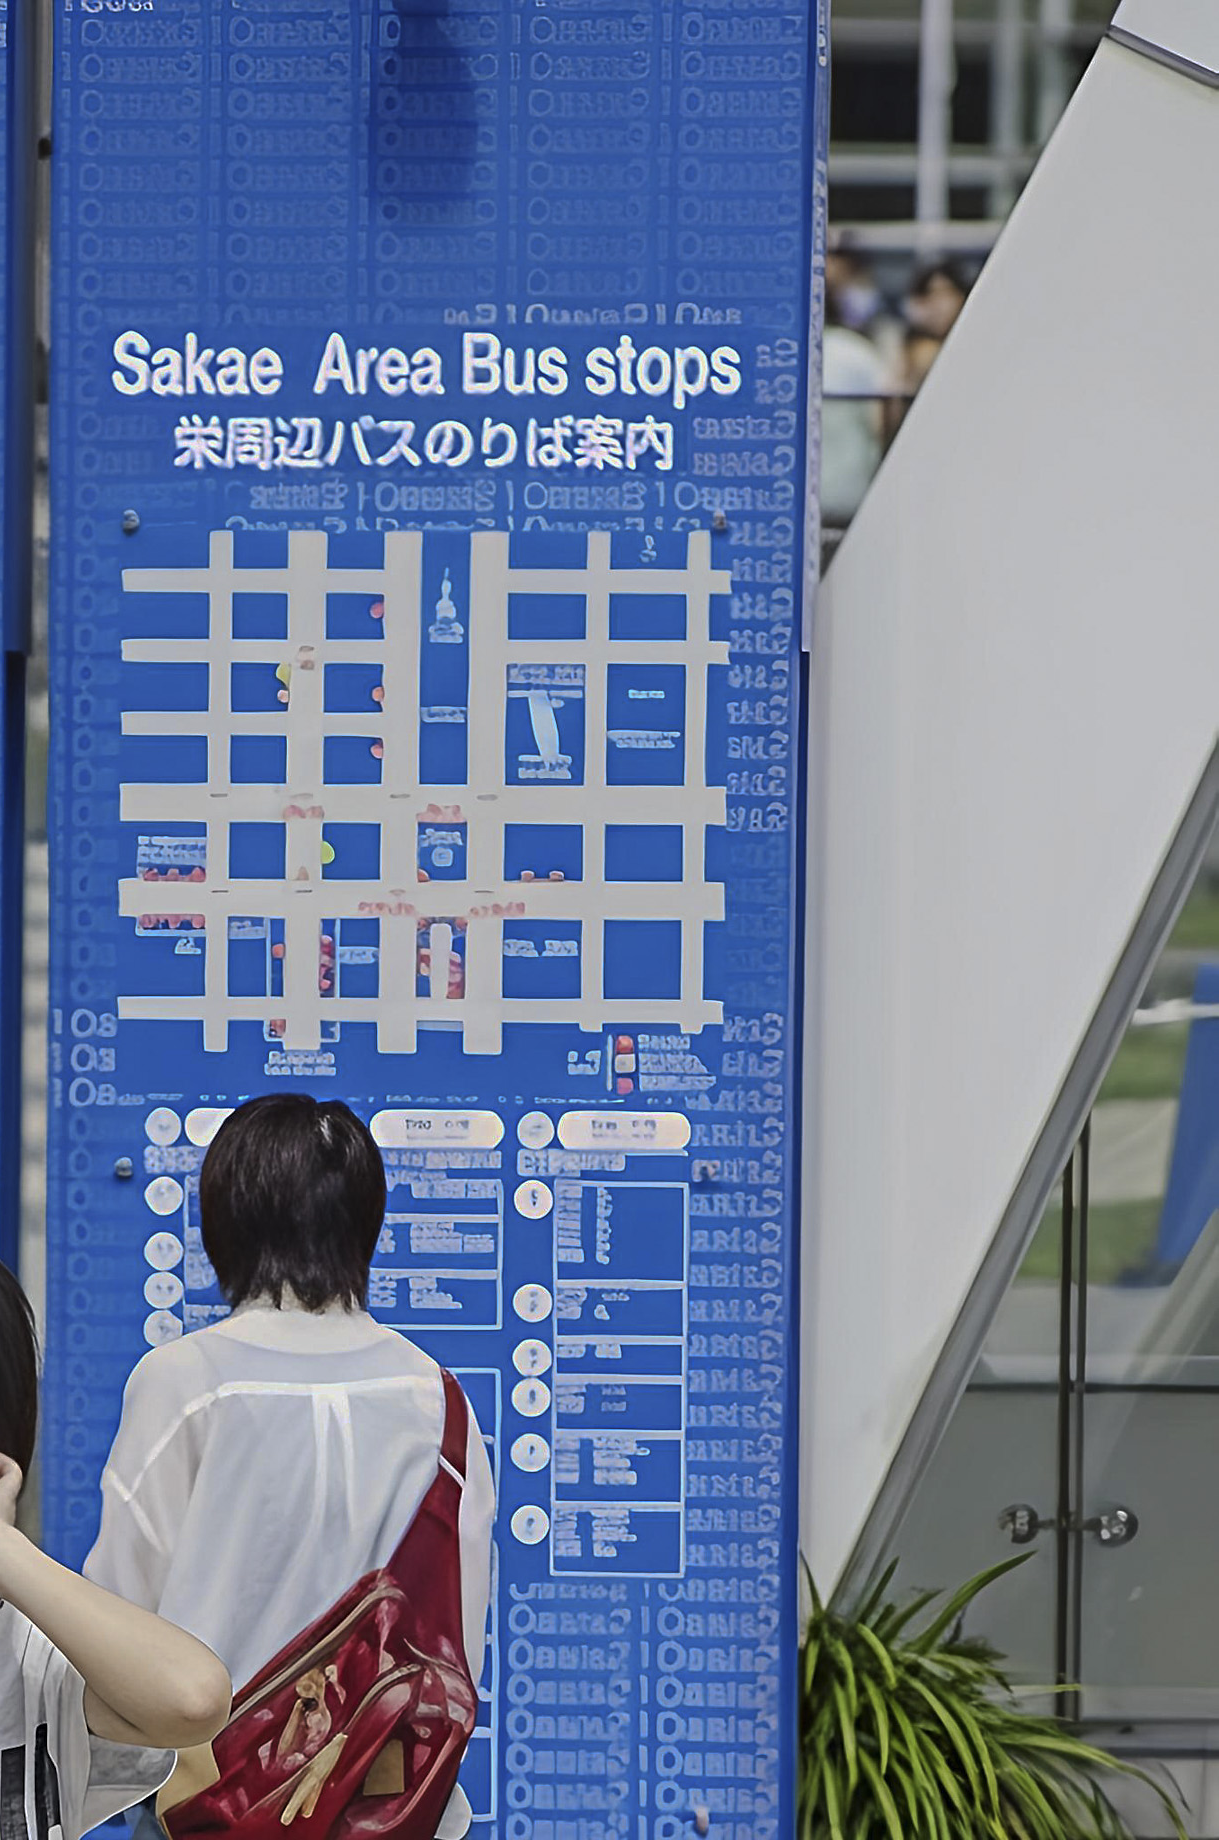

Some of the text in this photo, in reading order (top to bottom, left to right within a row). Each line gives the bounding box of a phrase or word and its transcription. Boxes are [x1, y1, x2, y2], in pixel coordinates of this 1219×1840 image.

[111, 329, 283, 396] Sakae
[313, 331, 444, 396] Area
[462, 332, 569, 396] Bus
[585, 334, 742, 410] stops
[173, 413, 675, 471] 栄周辺バスのりば案内
